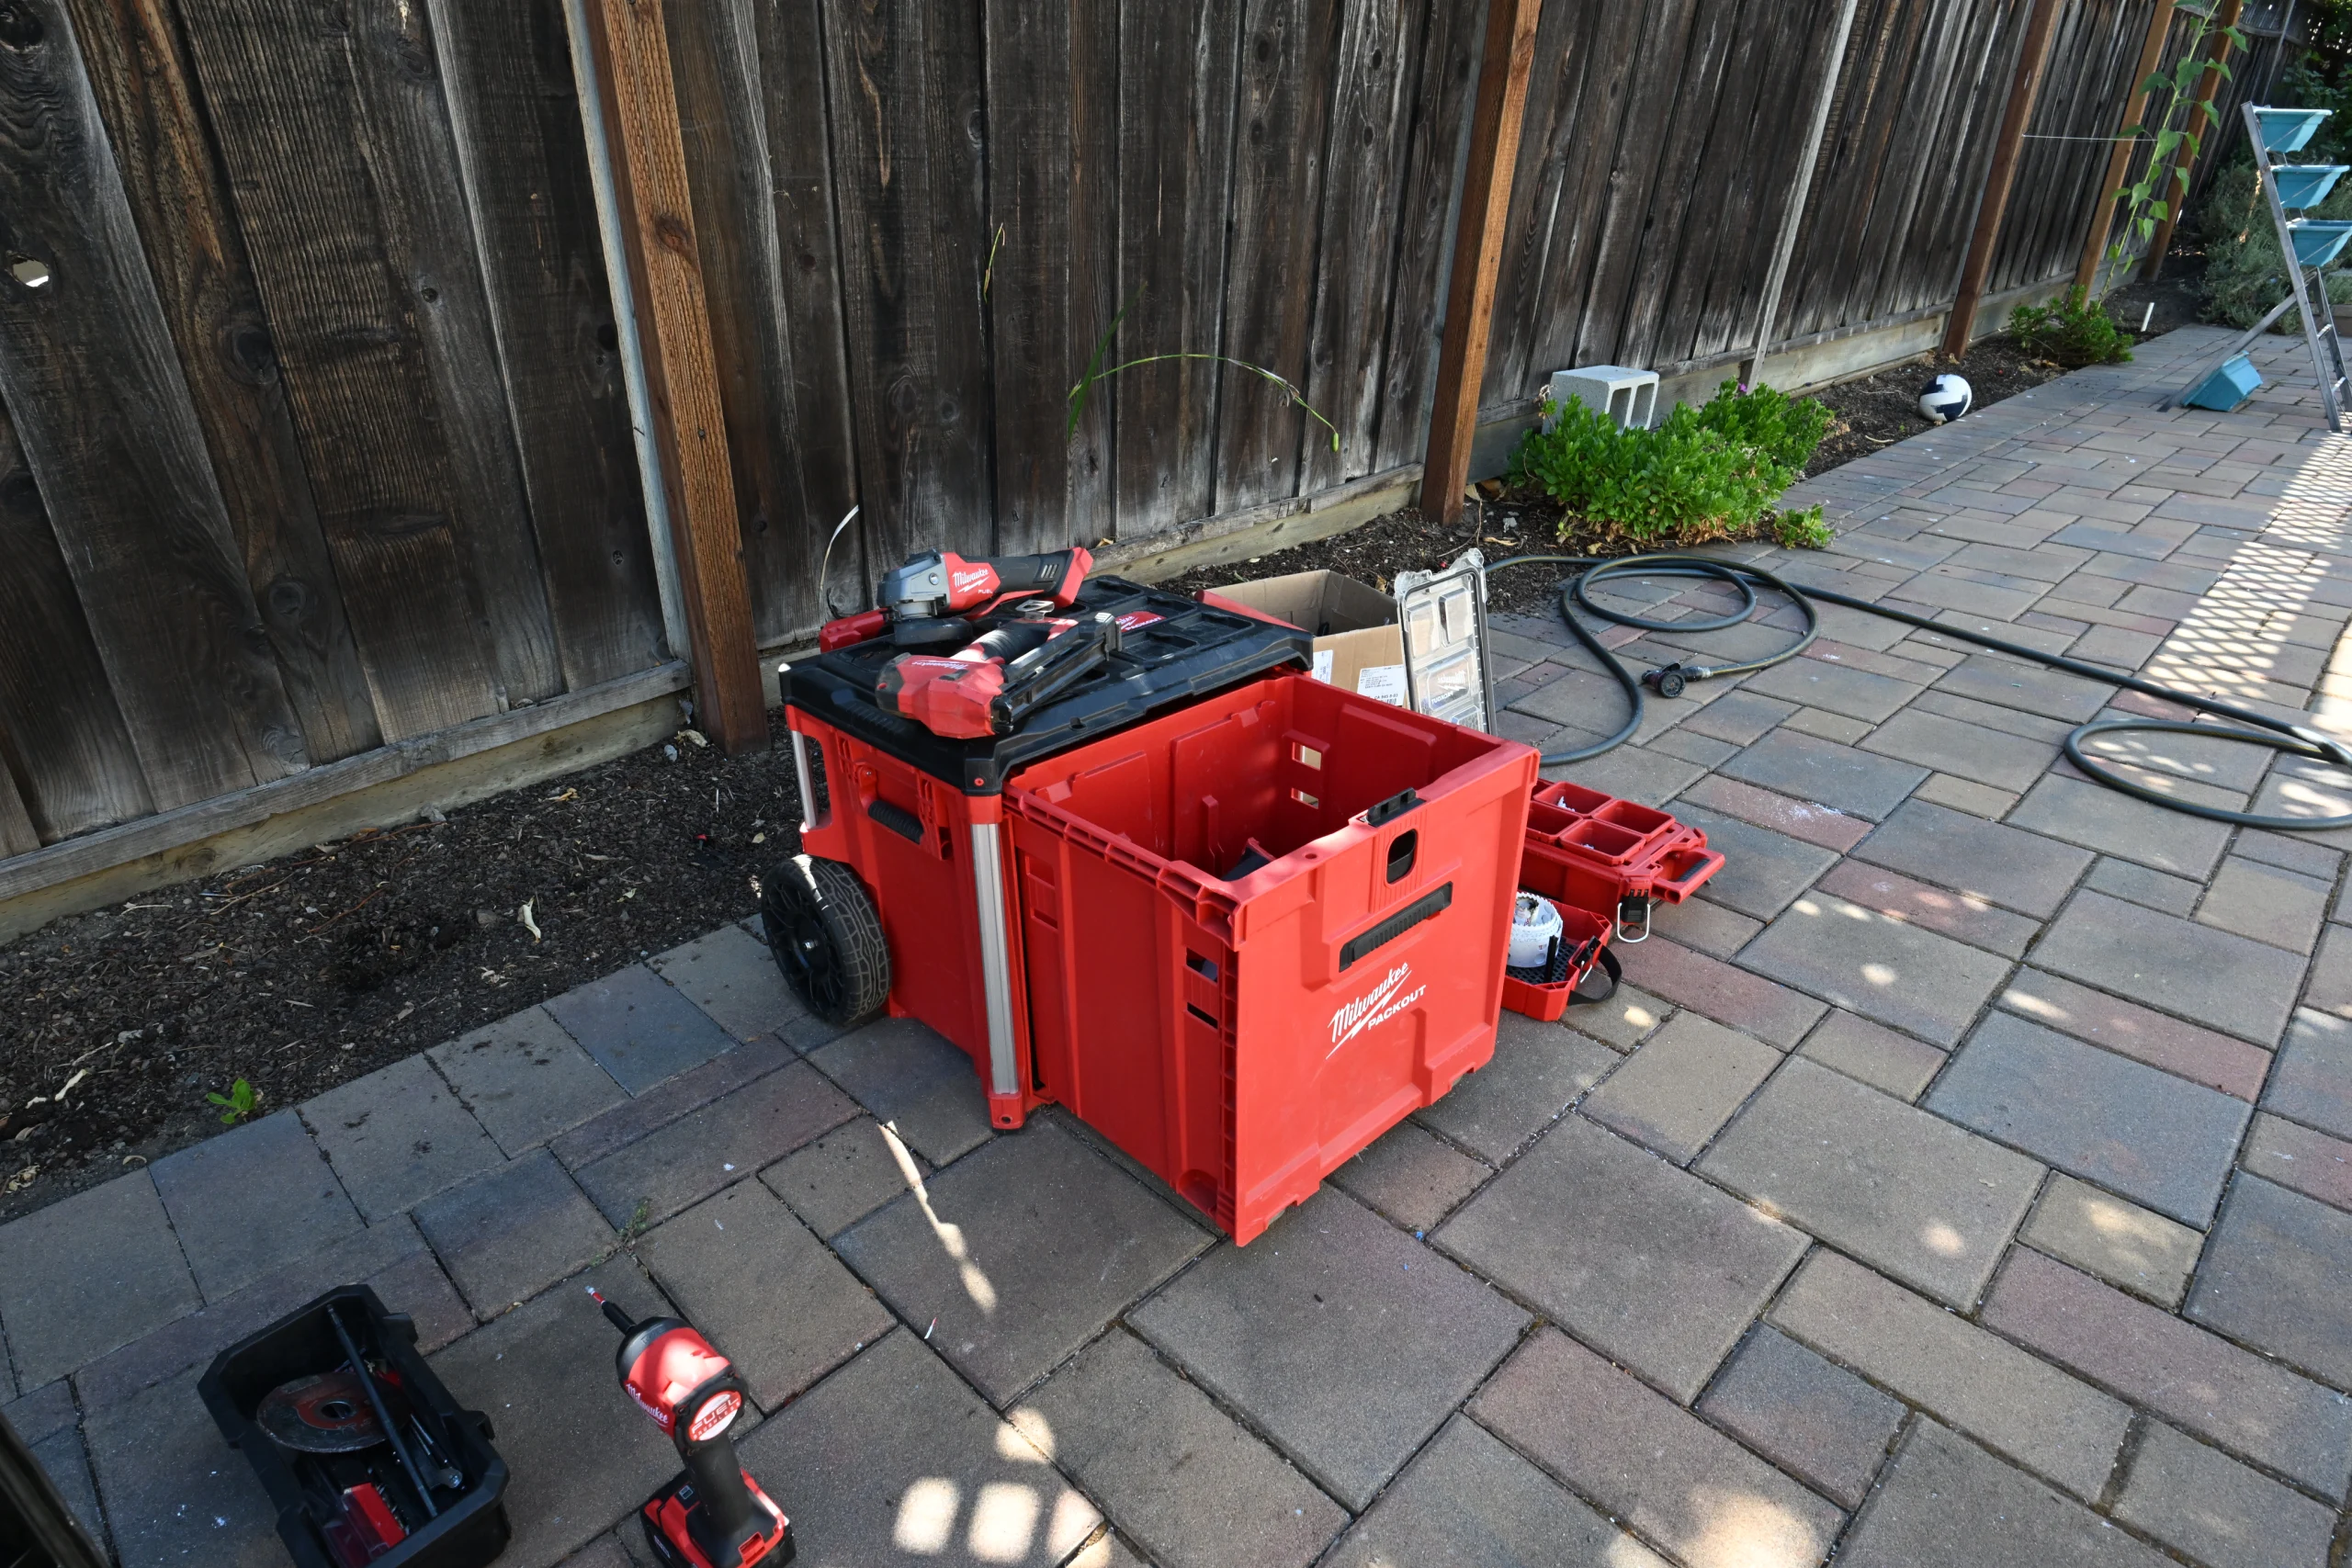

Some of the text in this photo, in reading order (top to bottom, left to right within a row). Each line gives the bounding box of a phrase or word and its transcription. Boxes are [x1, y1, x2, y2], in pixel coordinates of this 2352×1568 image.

[952, 569, 989, 587] Milwaukee
[1328, 962, 1408, 1043] Milwaukee
[1368, 984, 1426, 1031] PACKOUT
[626, 1383, 669, 1424] Milwaukee
[692, 1398, 739, 1434] FUEL
